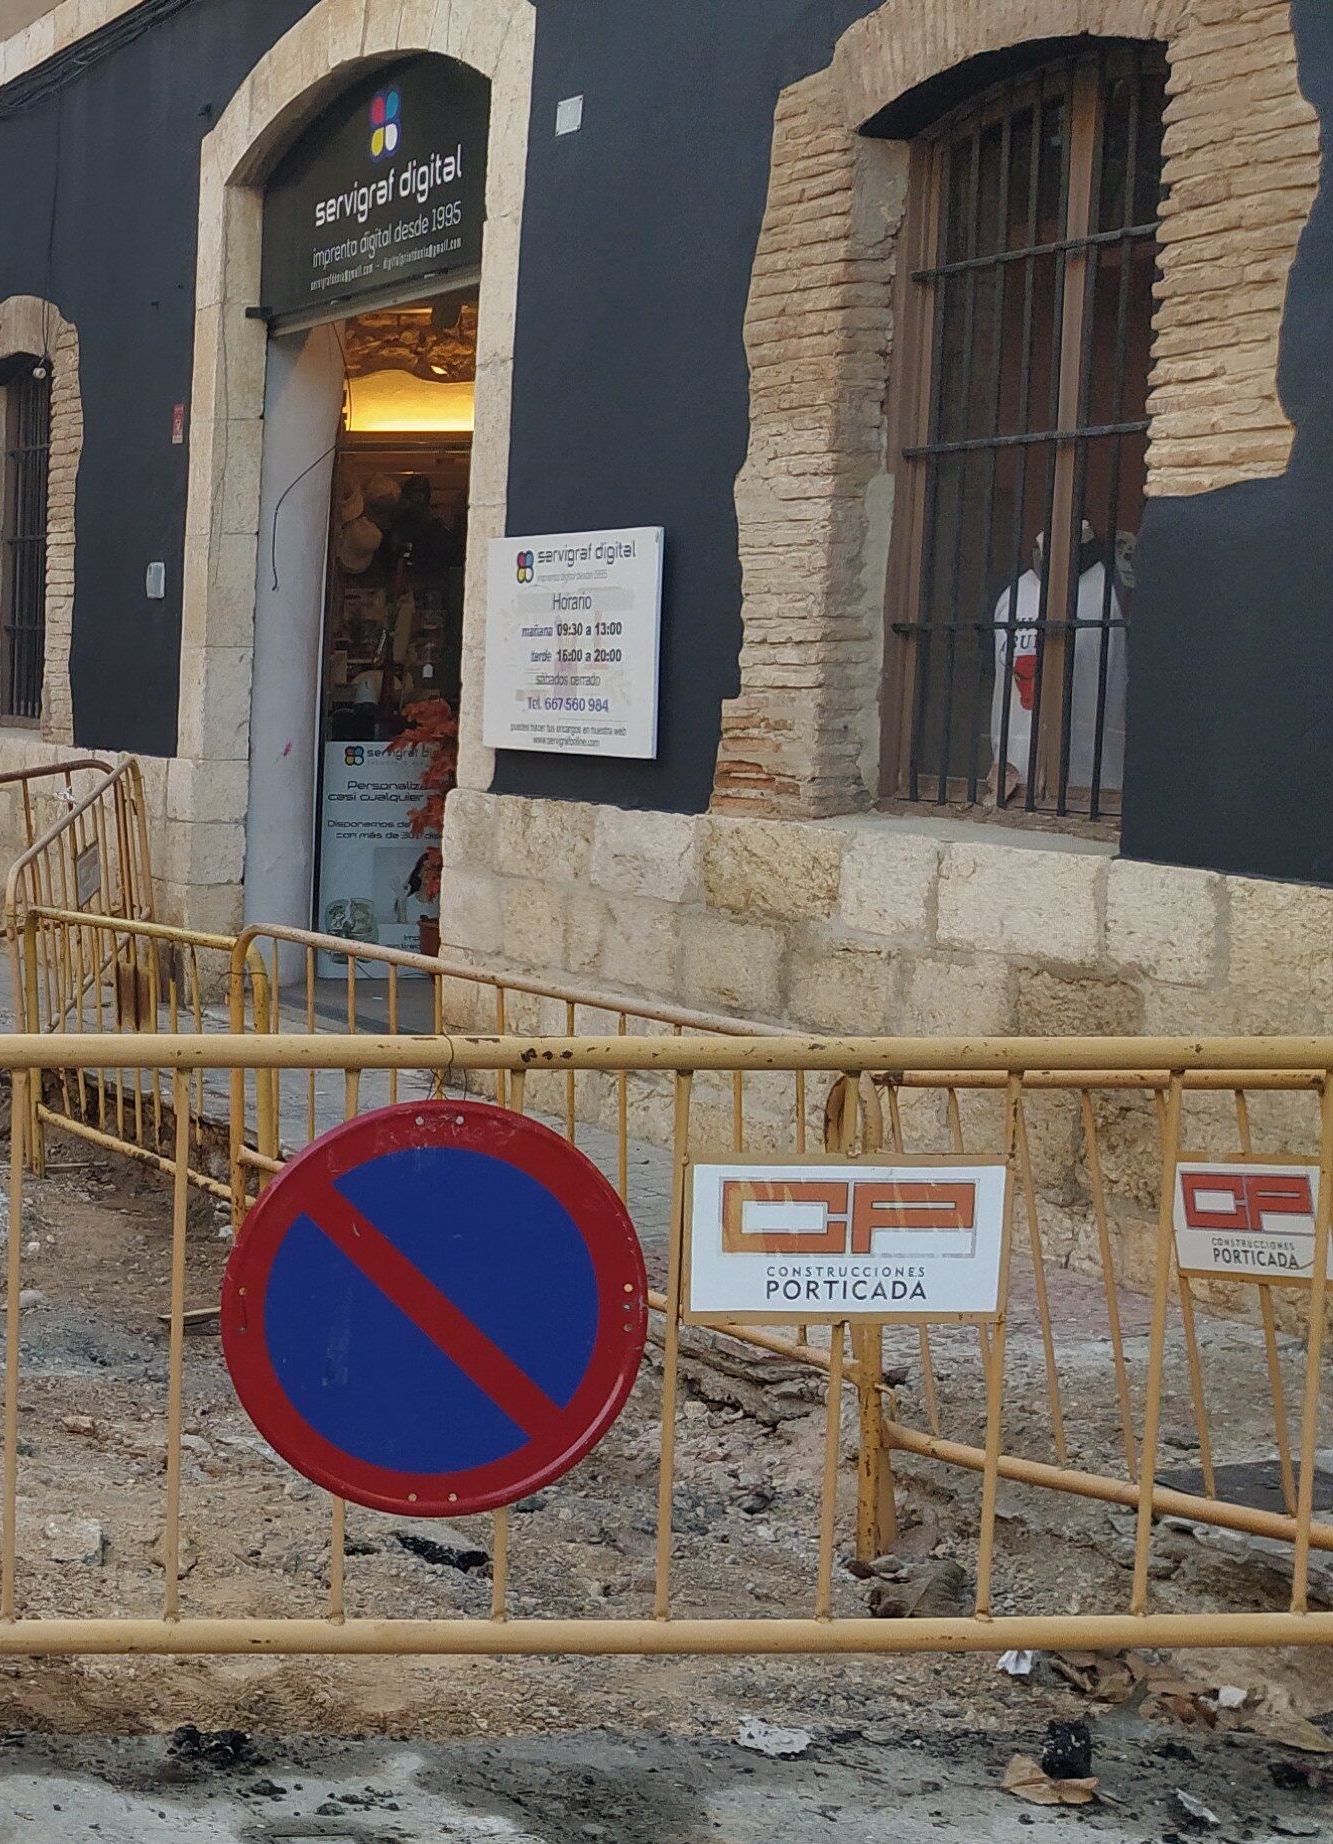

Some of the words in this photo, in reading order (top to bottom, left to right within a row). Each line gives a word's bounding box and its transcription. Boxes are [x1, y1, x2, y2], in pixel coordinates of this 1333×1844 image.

[315, 168, 395, 228] servigraf
[399, 144, 463, 204] digital
[313, 240, 358, 270] imprenta
[360, 224, 392, 259] digital
[394, 213, 429, 243] desde
[432, 201, 463, 232] 1995
[538, 544, 593, 568] servigraf
[595, 540, 637, 565] digital
[553, 592, 592, 611] Horario
[556, 622, 583, 637] 09:30
[585, 625, 592, 636] a
[595, 622, 622, 637] 13:00
[531, 650, 552, 663] tarde
[557, 648, 583, 663] 16:00
[585, 652, 592, 663] a
[594, 648, 622, 663] 20:00
[536, 673, 569, 687] sábados
[570, 674, 602, 688] cerrado
[328, 793, 357, 802] casi
[360, 793, 424, 803] cualquier
[328, 819, 395, 829] Disponemos
[385, 831, 400, 839] de
[1180, 1172, 1313, 1232] CP
[721, 1179, 976, 1255] CP
[1212, 1236, 1296, 1251] CONSTRUCCIONES
[1213, 1247, 1300, 1268] PORTICADA
[766, 1265, 926, 1279] CONSTRUCCIONES
[765, 1279, 928, 1301] PORTICADA
